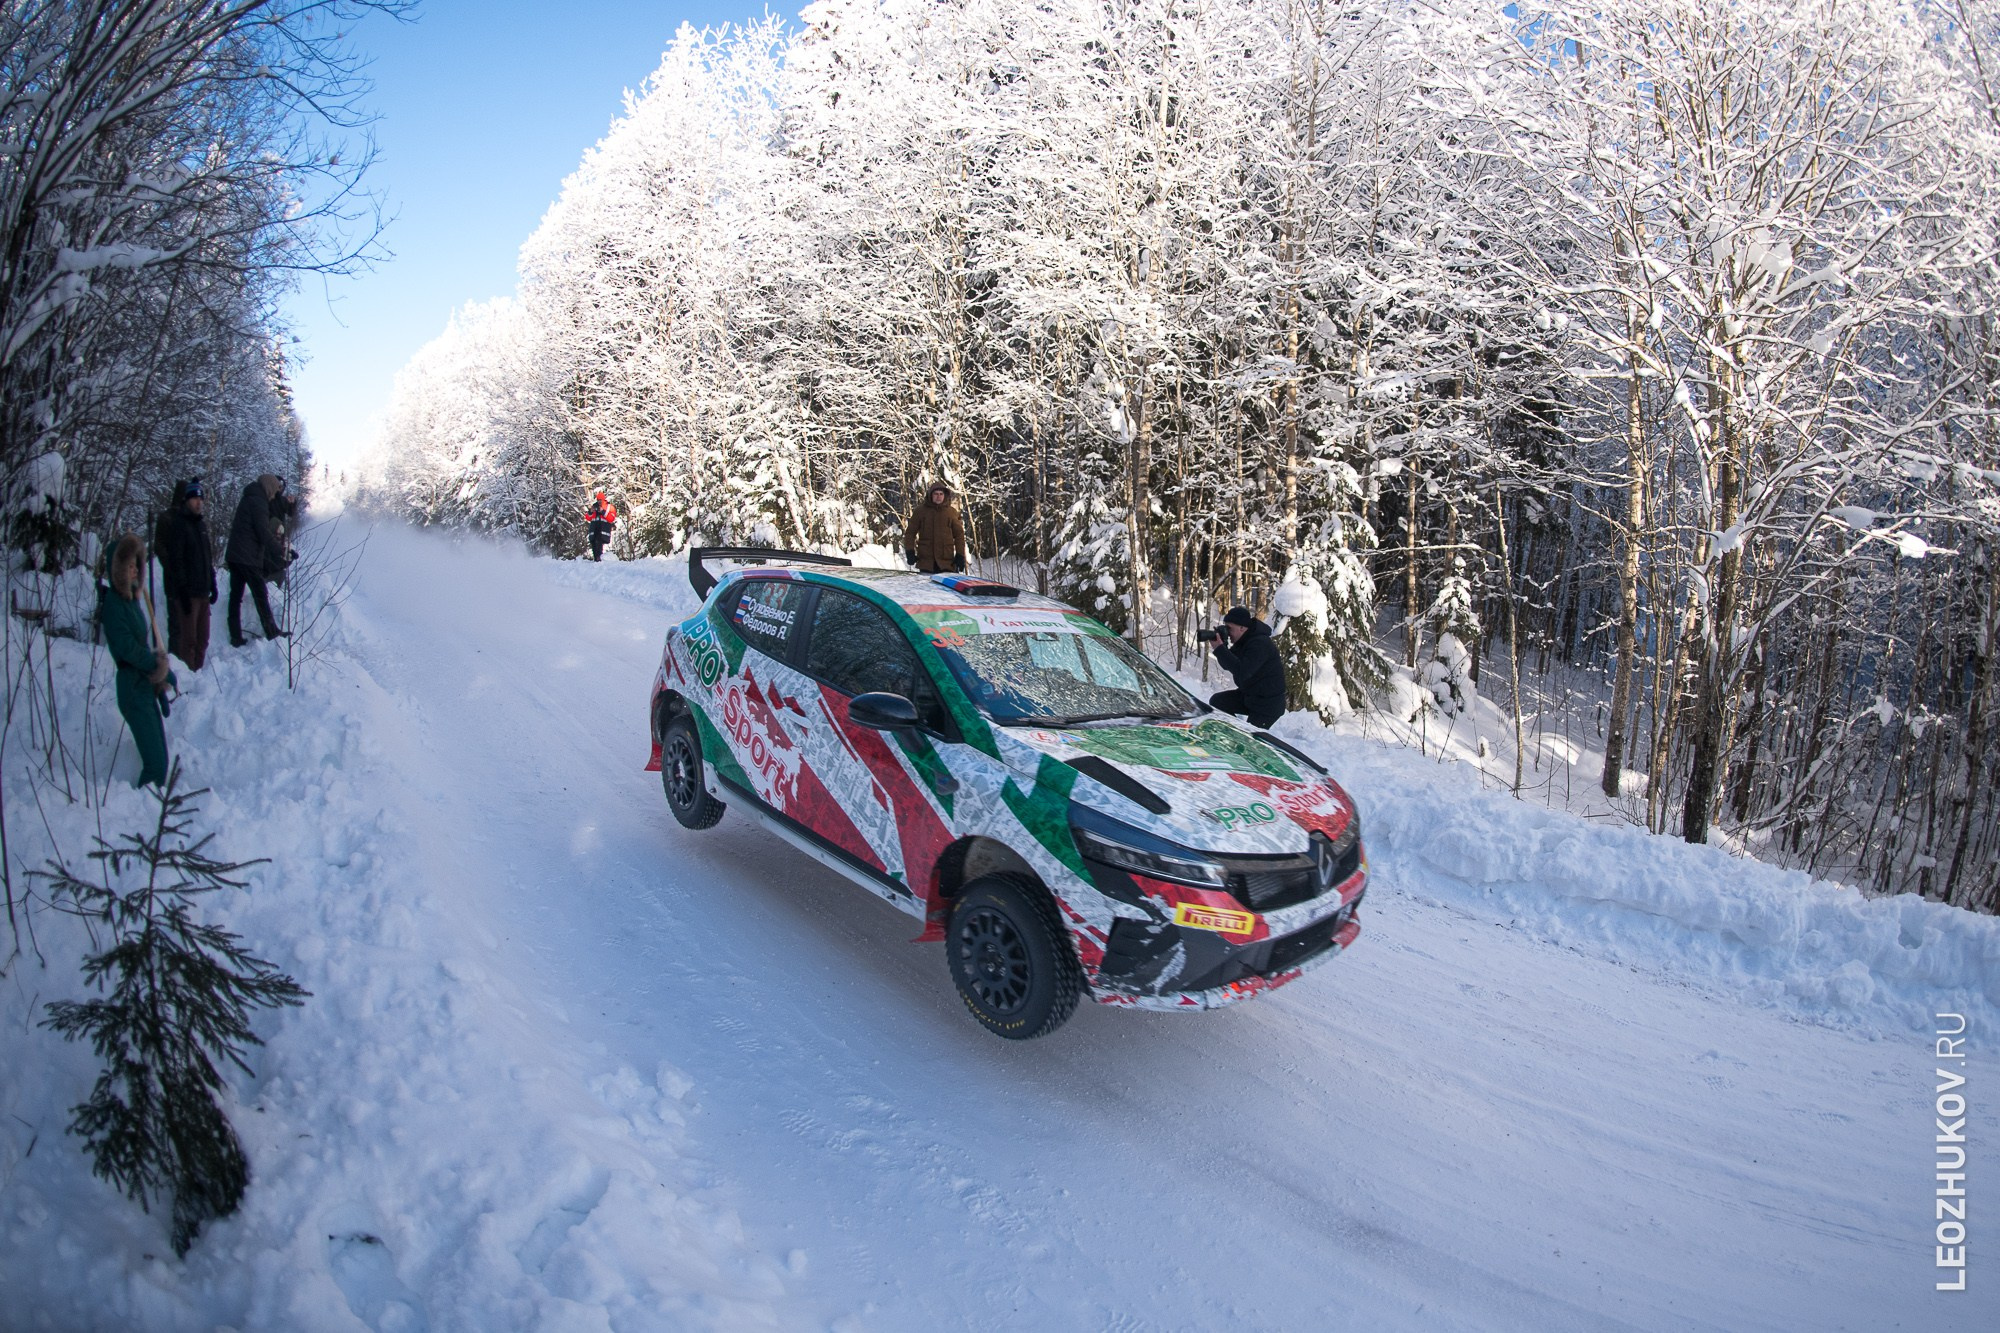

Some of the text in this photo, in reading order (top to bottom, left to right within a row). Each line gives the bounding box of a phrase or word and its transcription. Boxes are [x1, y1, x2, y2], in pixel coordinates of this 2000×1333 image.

[776, 625, 787, 640] Я
[924, 626, 966, 648] 33
[1183, 907, 1248, 930] PIRELLI
